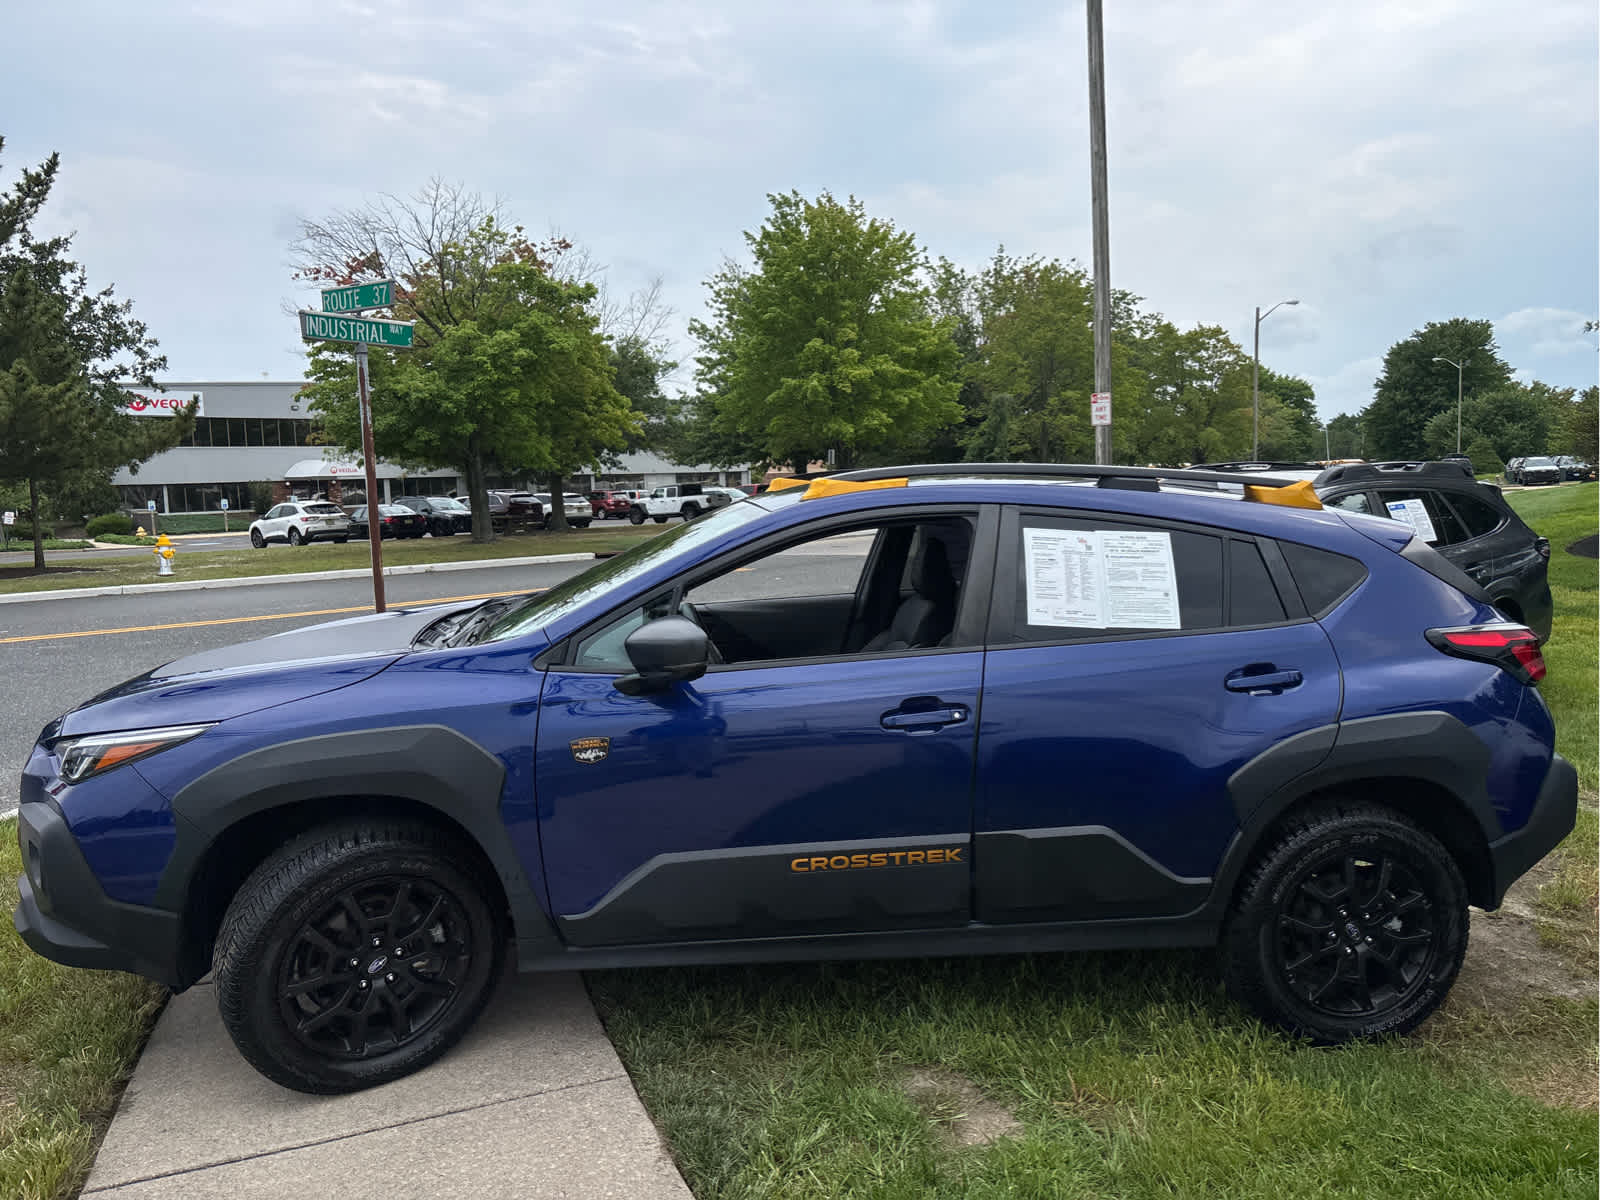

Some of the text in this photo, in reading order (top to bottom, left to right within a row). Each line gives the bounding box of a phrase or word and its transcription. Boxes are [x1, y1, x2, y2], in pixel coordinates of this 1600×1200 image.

[322, 285, 388, 312] ROUTE 37
[305, 315, 404, 343] INDUSTRIAL WAY
[790, 847, 964, 873] CROSSTREK
